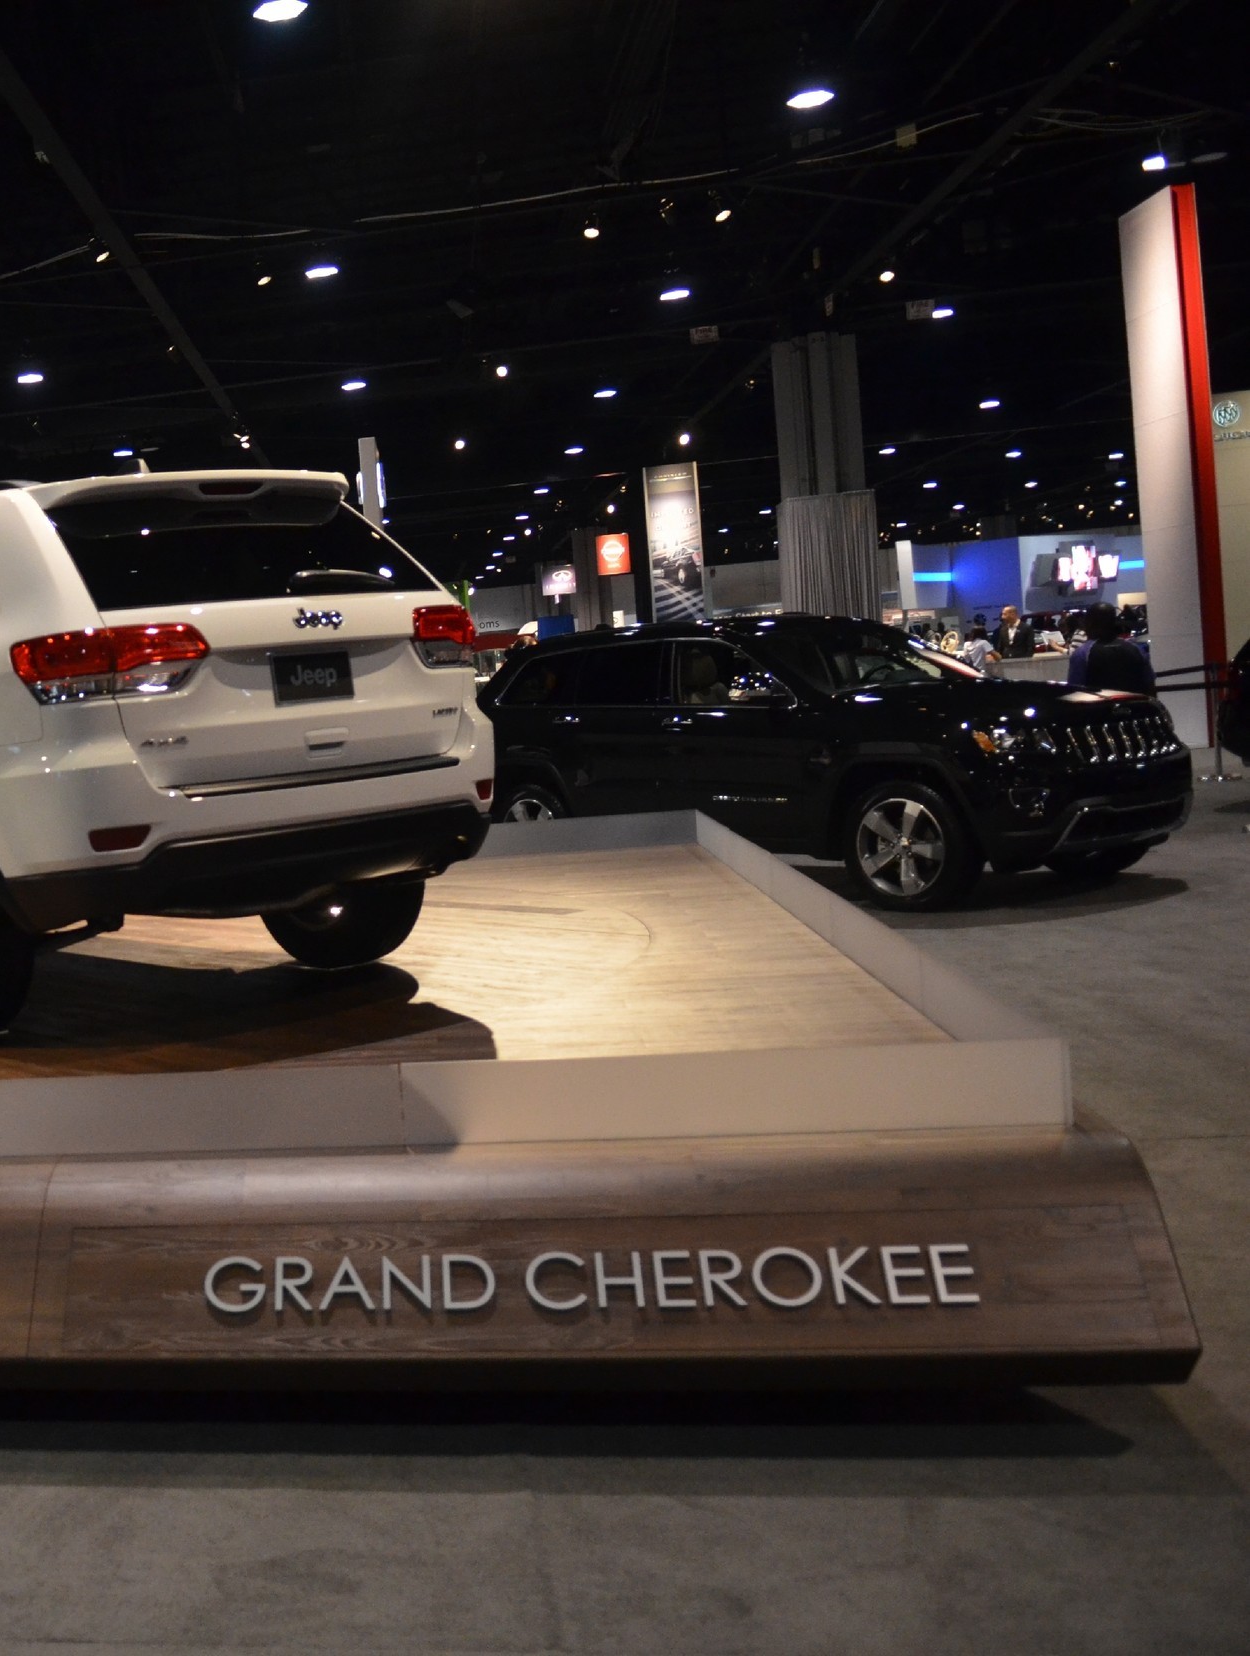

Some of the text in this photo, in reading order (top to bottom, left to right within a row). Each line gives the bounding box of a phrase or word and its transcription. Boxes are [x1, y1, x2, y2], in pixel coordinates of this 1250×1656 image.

[293, 607, 343, 631] Jeep
[479, 619, 500, 630] oms
[290, 664, 338, 687] Jeep
[204, 1243, 981, 1313] GRAND CHEROKEE
